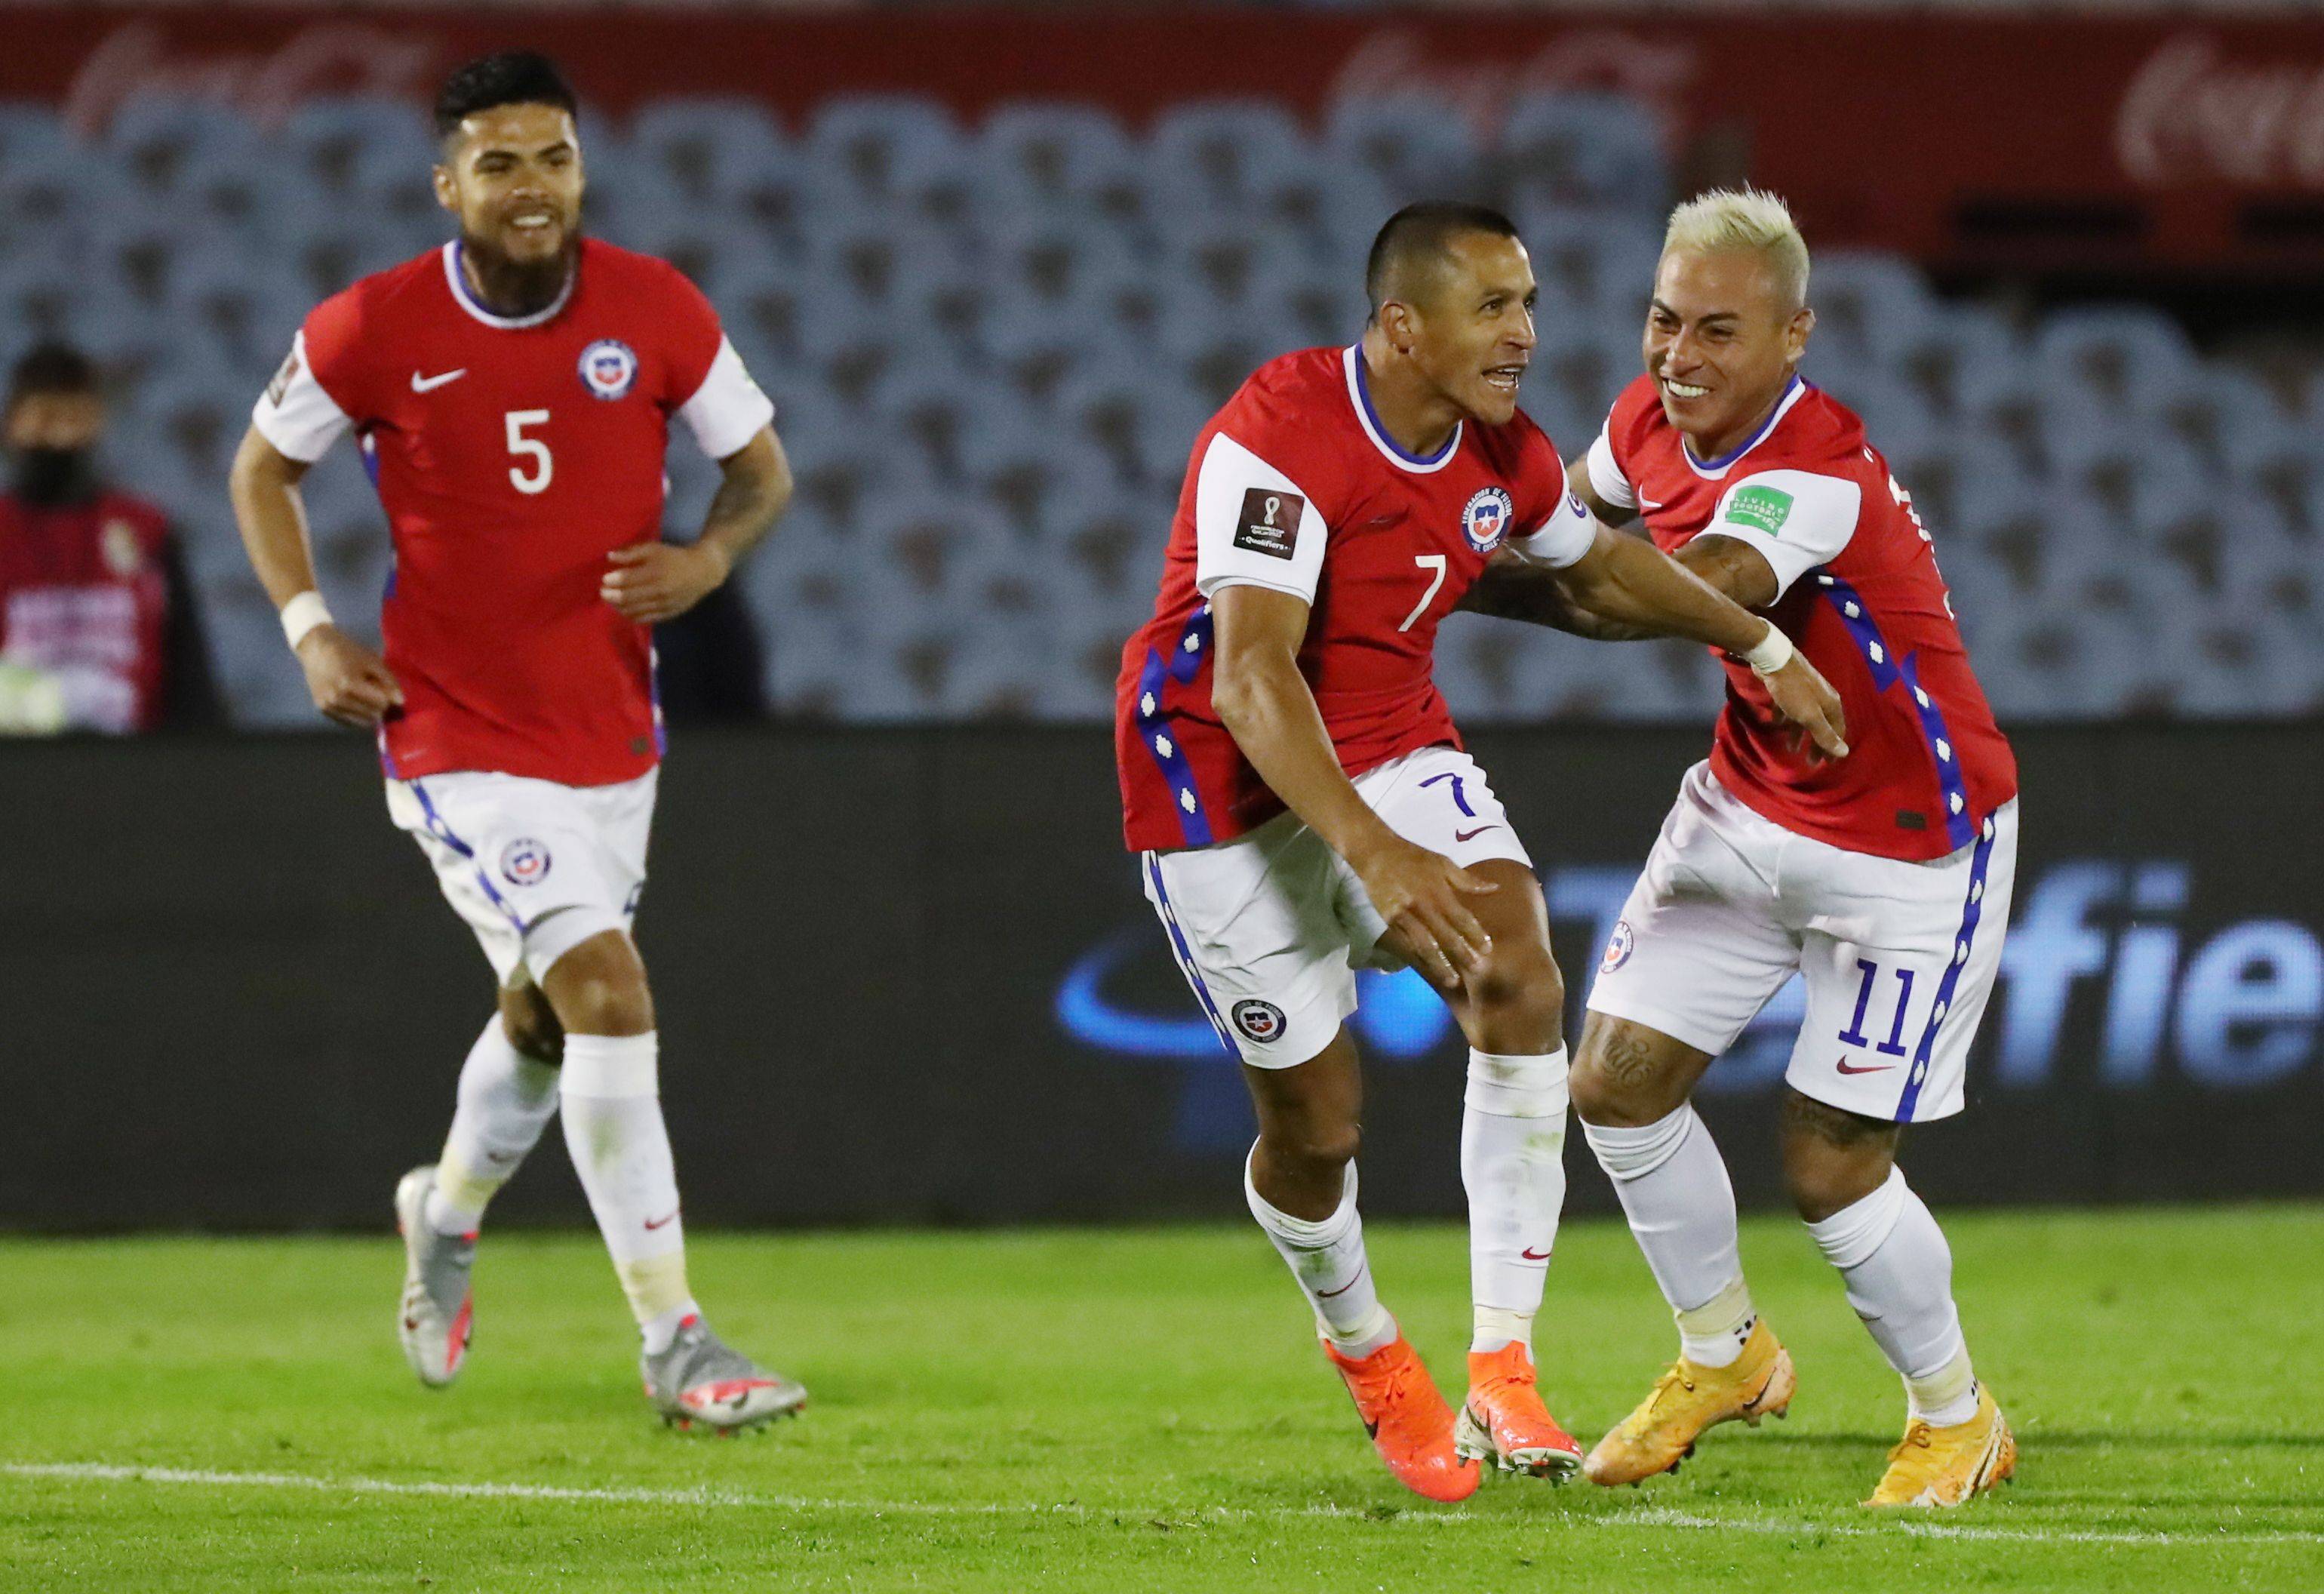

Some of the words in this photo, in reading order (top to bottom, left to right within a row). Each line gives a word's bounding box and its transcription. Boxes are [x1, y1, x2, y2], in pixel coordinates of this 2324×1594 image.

[504, 408, 552, 494] 5
[1397, 554, 1446, 632] 7
[1418, 772, 1477, 817] 7
[1838, 957, 1915, 1057] 11
